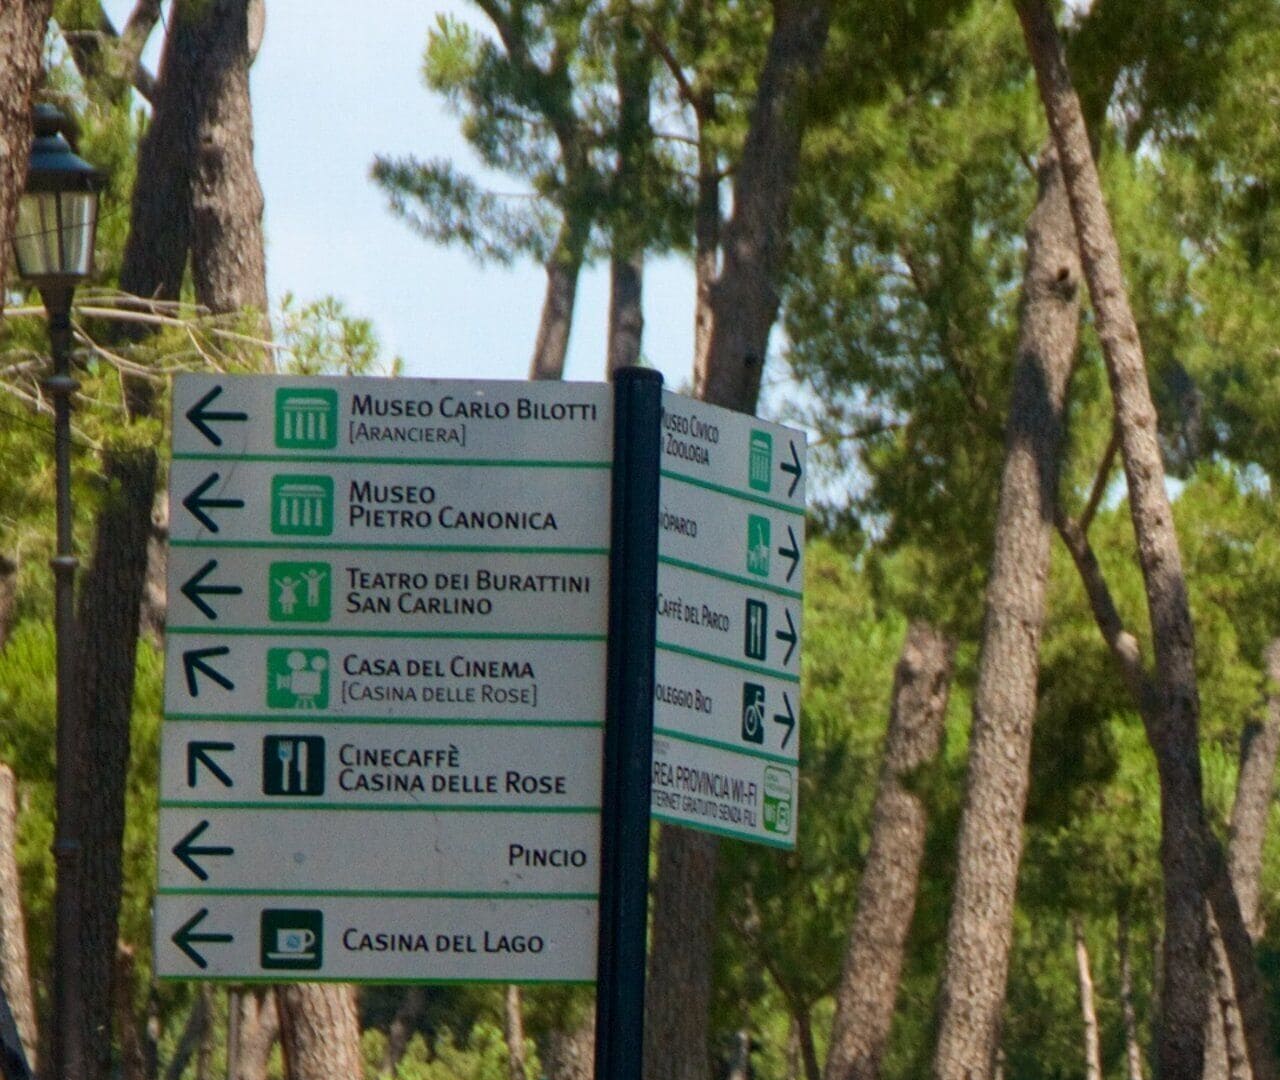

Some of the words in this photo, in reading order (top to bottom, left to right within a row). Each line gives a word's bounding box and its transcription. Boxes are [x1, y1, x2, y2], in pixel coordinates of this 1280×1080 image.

[351, 394, 434, 418] MUSEO
[439, 396, 511, 420] CARLO
[516, 397, 597, 421] BILOTTI
[661, 407, 688, 435] USEO
[349, 480, 436, 505] MUSEO
[349, 504, 433, 529] PIETRO
[437, 505, 558, 531] CANONICA
[345, 567, 429, 590] TEATRO
[434, 573, 469, 591] DEI
[476, 569, 590, 594] BURATTINI
[346, 591, 391, 614] SAN
[397, 592, 493, 616] CARLINO
[343, 653, 401, 677] CASA
[406, 659, 445, 678] DEL
[449, 655, 535, 679] CINEMA
[421, 686, 476, 703] DELLE
[655, 684, 693, 709] OLEGGIO
[338, 743, 460, 768] CINECAFFÈ
[338, 767, 425, 792] CASINA
[431, 774, 498, 794] DELLE
[505, 770, 567, 795] ROSE
[652, 761, 673, 787] REA
[508, 843, 587, 868] PINCIO
[342, 927, 430, 952] CASINA
[435, 934, 477, 953] DEL
[483, 930, 545, 954] LAGO
